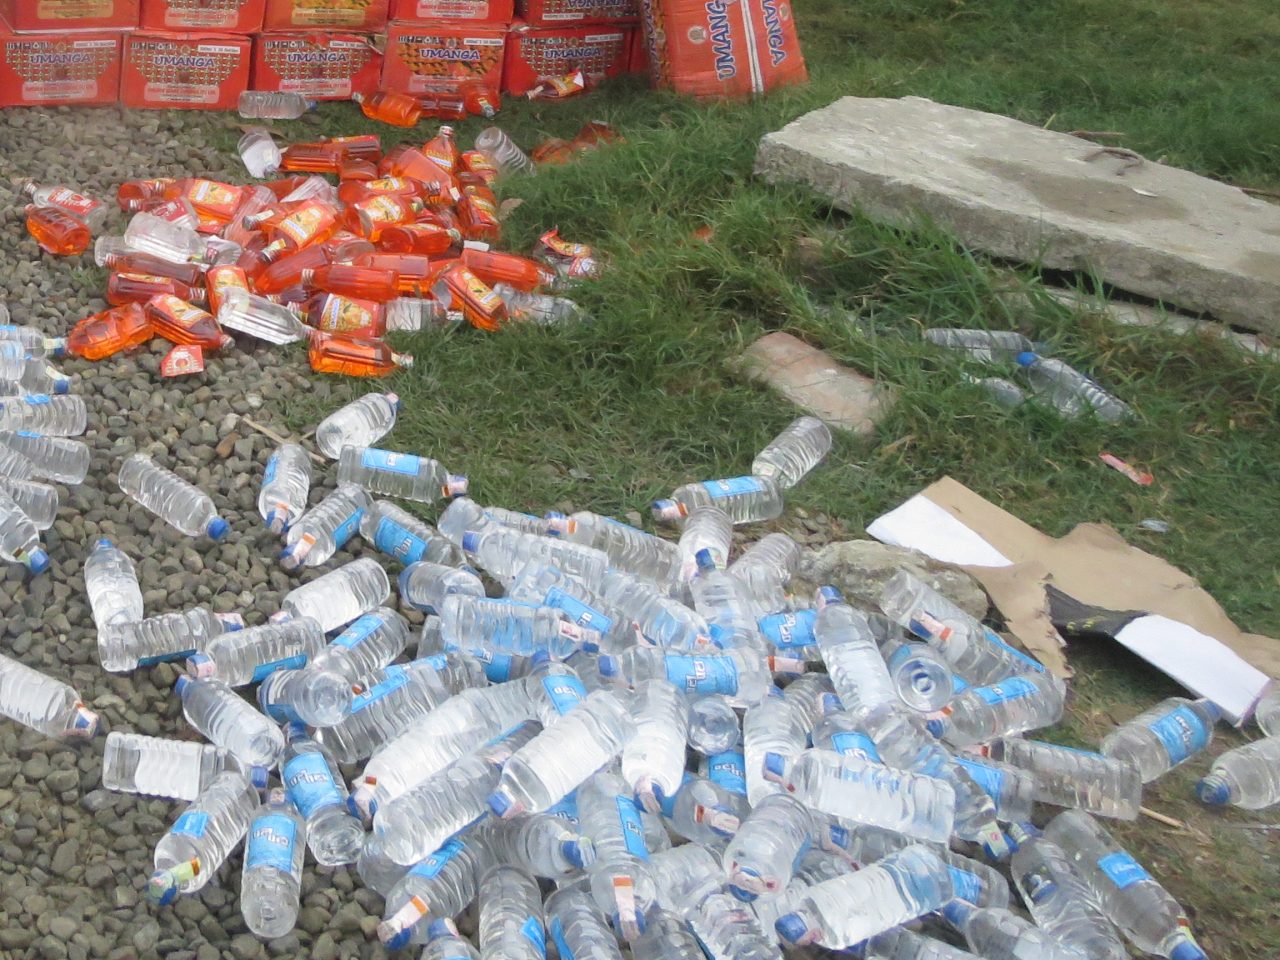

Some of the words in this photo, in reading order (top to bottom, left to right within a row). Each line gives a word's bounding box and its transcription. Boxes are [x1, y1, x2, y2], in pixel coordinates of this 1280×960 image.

[29, 53, 94, 66] UMANGA
[286, 50, 347, 63] UMANGA
[419, 48, 480, 61] UMANGA
[544, 47, 602, 60] UMANGA
[153, 55, 214, 68] UMANGA
